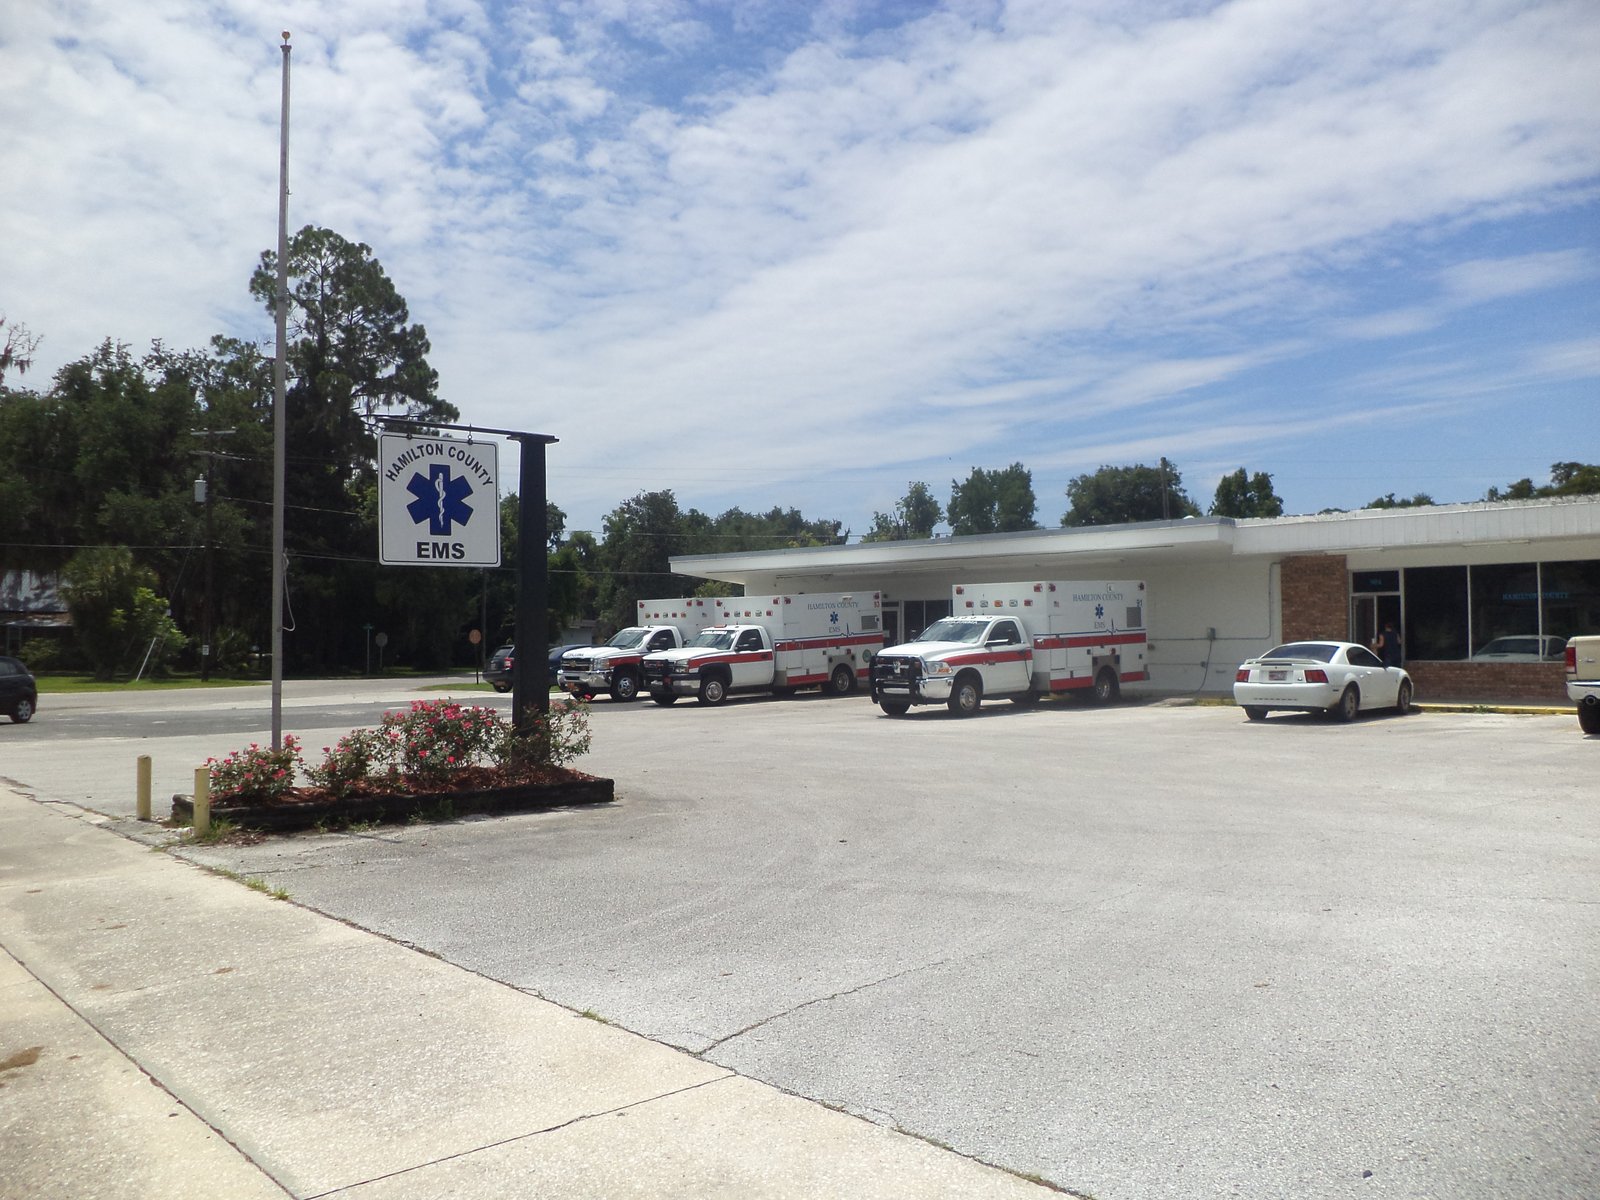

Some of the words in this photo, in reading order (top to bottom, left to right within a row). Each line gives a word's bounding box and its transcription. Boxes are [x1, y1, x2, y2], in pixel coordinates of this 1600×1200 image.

[385, 443, 444, 482] HAMILTON
[448, 446, 493, 486] COUNTY
[416, 541, 465, 560] EMS
[1072, 594, 1101, 602] HAMILTON
[1102, 593, 1123, 601] COUNTY
[807, 602, 836, 610] HAMILTON
